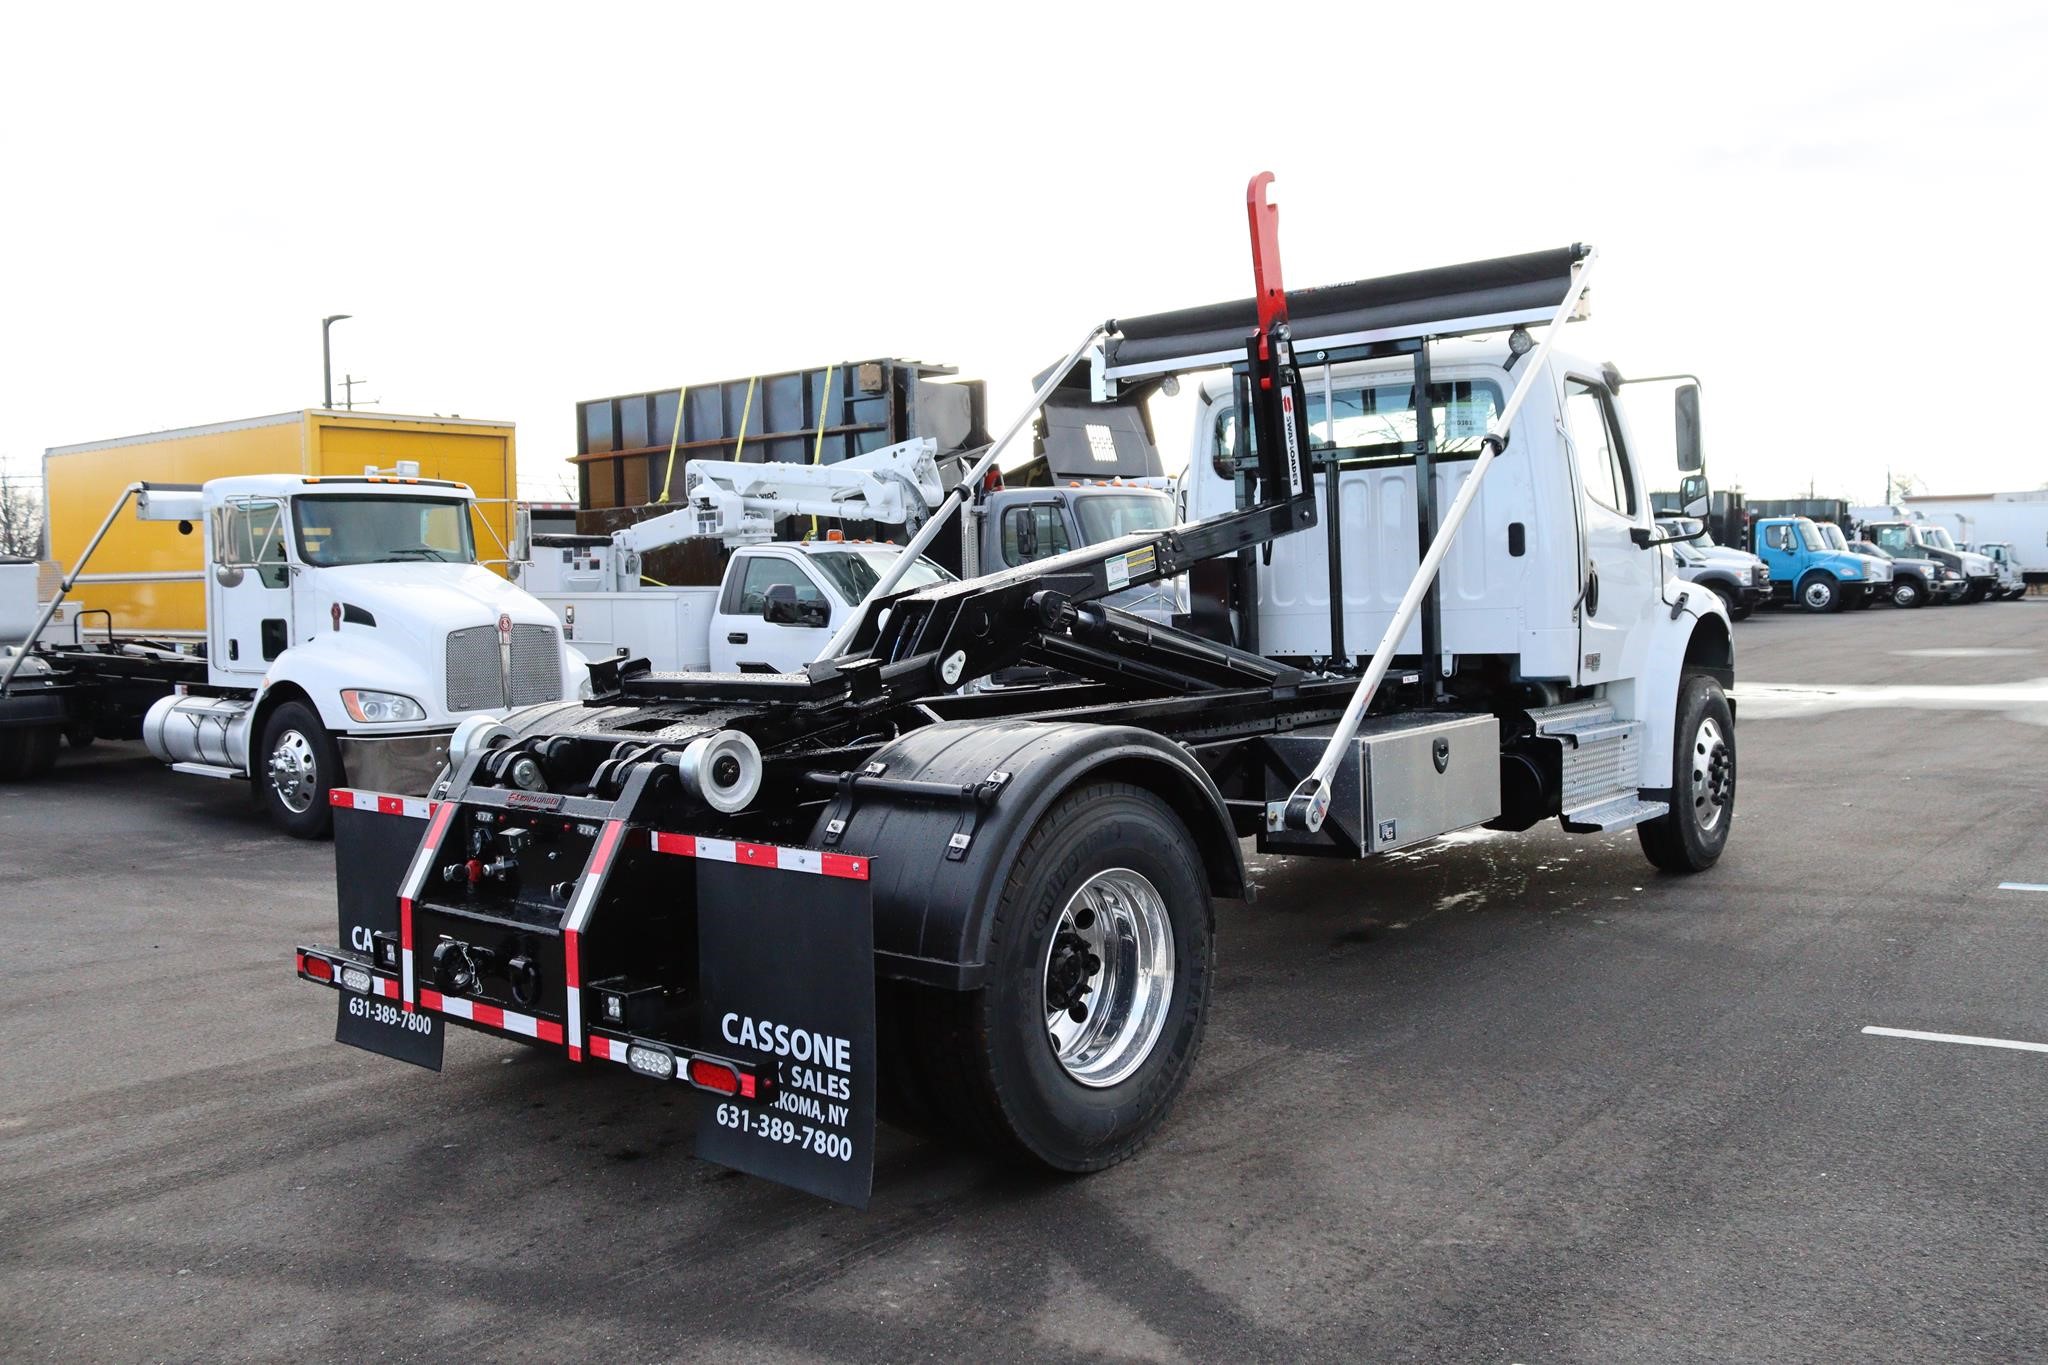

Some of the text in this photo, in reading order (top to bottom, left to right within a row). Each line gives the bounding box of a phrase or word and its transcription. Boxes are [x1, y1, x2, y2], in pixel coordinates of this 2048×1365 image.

[1286, 416, 1299, 486] SWAPLOADER
[349, 996, 432, 1035] 631-389-7800
[721, 1012, 851, 1073] CASSONE
[791, 1065, 850, 1101] SALES
[716, 1103, 852, 1162] 631-389-7800
[828, 1103, 849, 1127] NY
